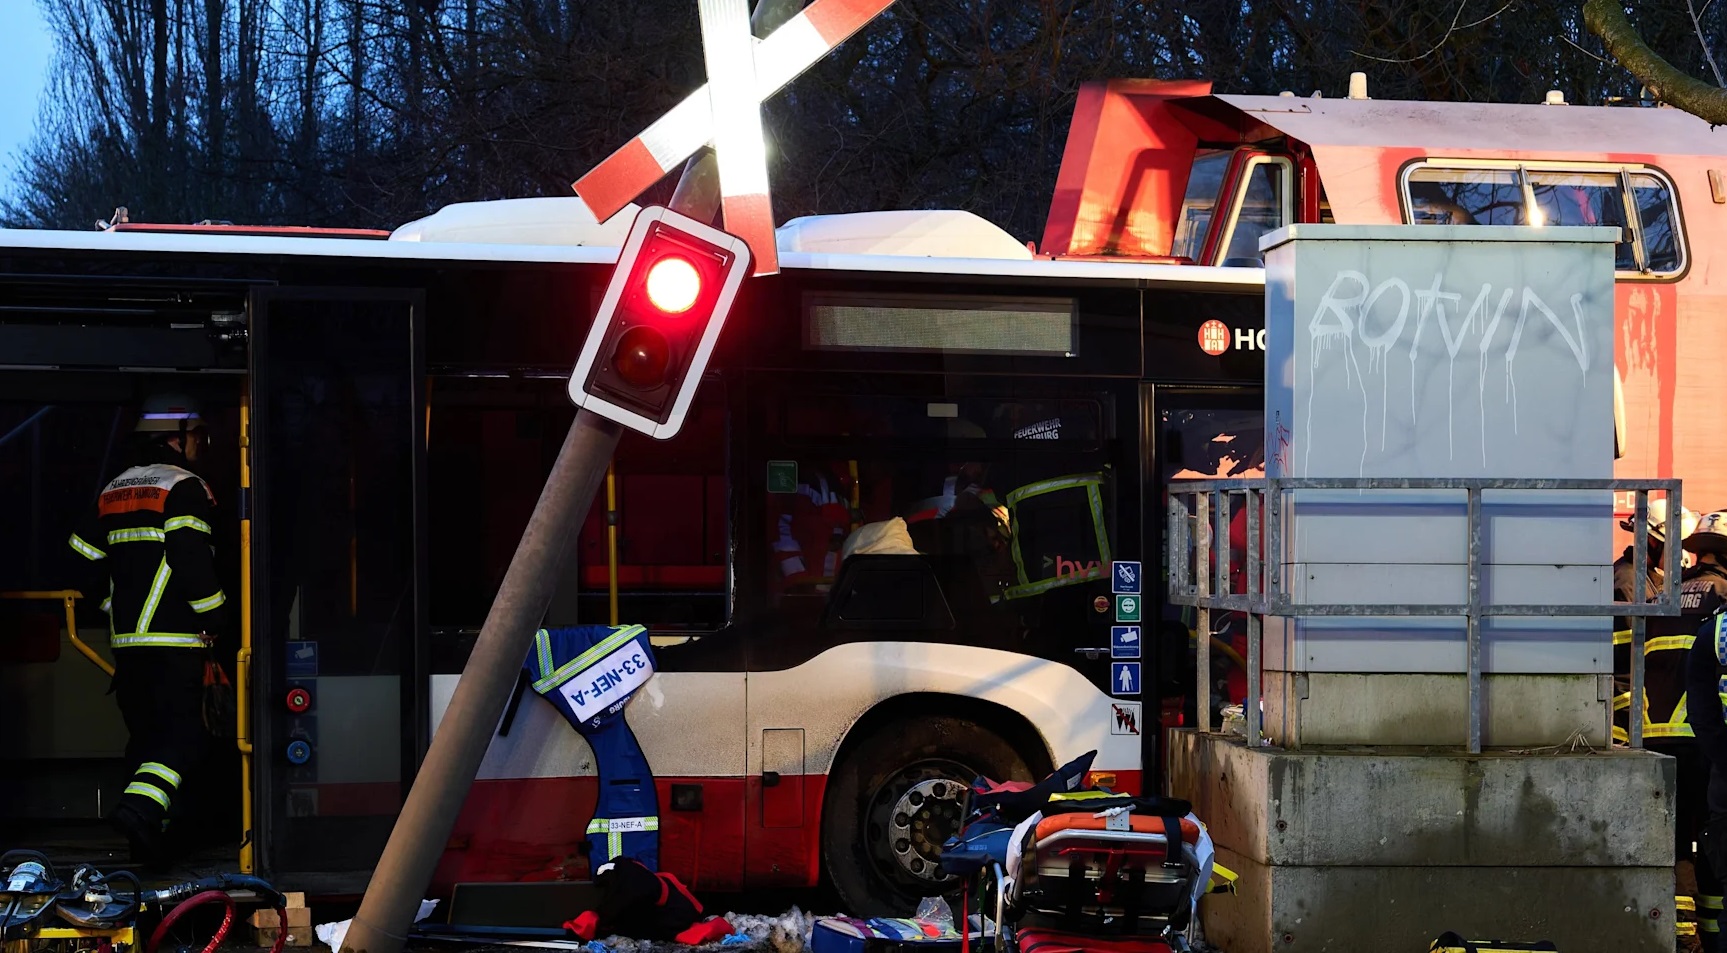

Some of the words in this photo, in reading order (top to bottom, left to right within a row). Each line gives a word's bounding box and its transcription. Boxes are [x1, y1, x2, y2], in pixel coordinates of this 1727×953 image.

[1013, 418, 1062, 439] FEUERWEHR
[1680, 593, 1702, 609] URG
[570, 653, 645, 707] 33-NEF-A
[611, 821, 643, 830] 33-NEF-A
